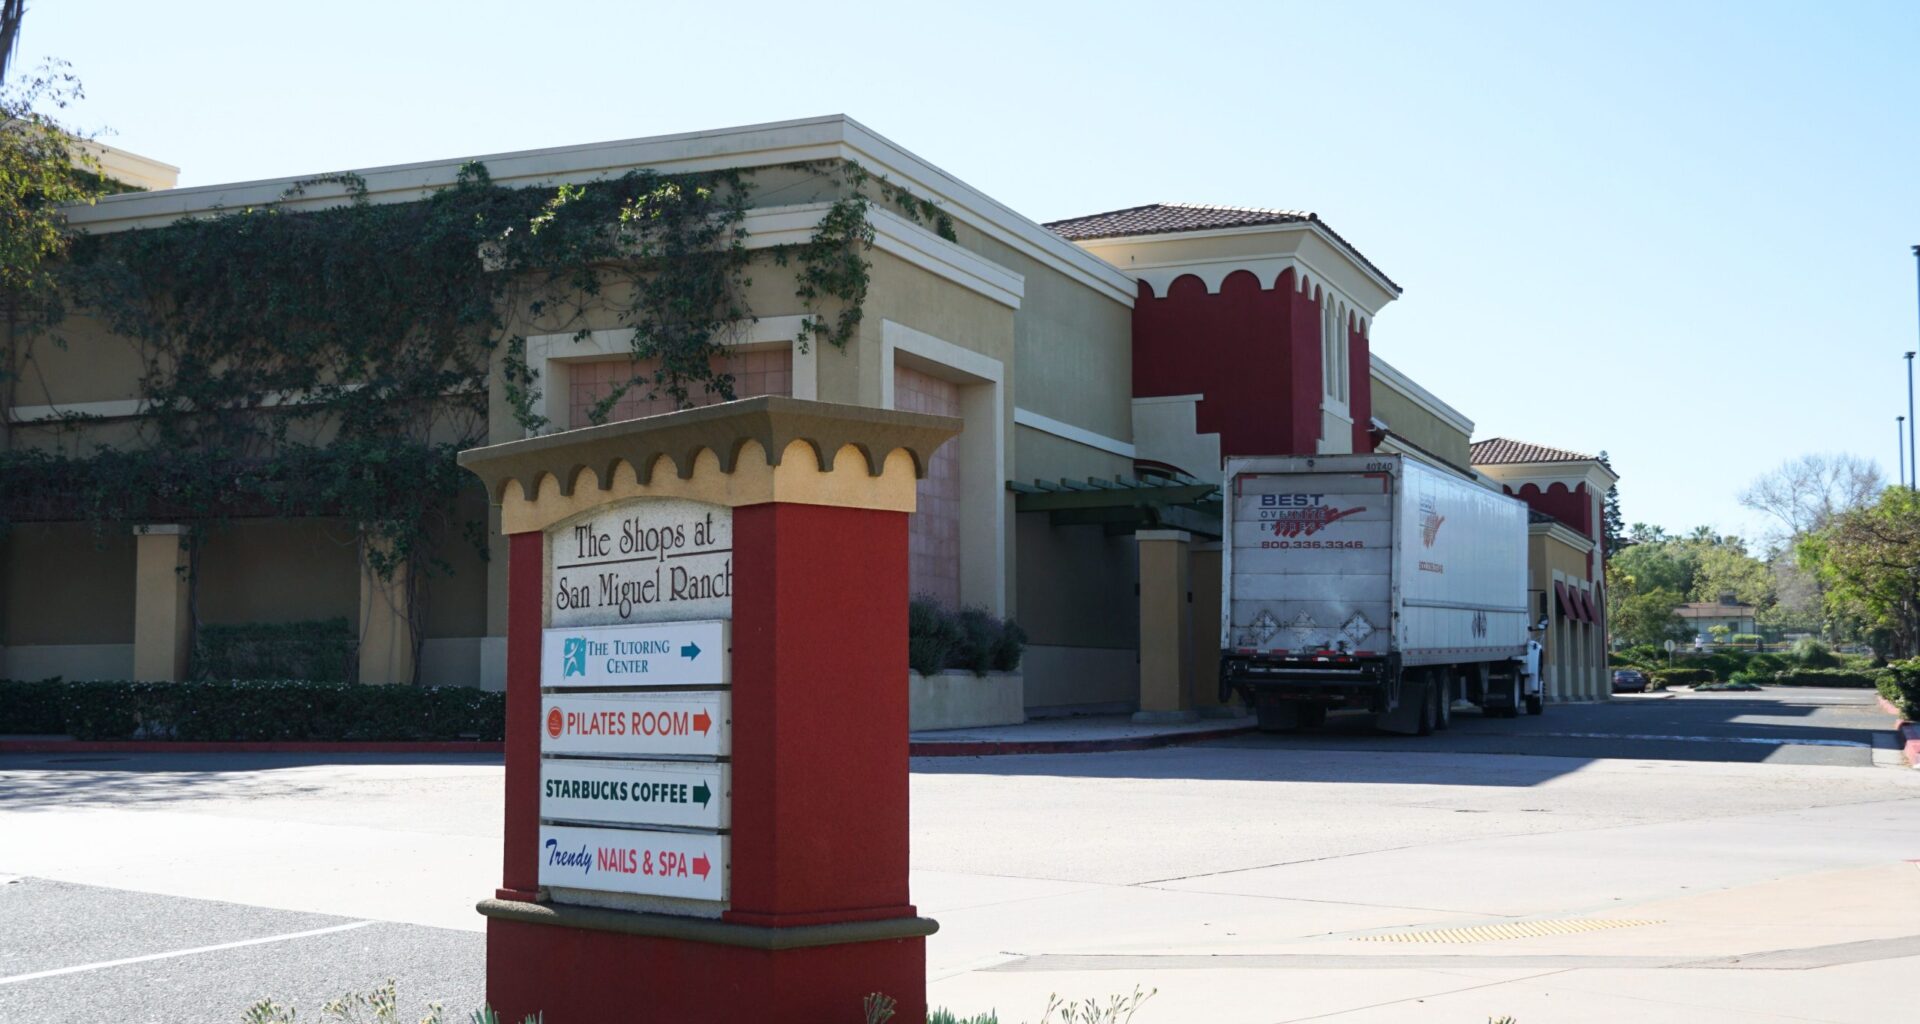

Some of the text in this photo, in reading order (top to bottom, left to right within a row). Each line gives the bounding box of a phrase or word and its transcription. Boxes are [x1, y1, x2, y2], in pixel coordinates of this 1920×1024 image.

[1261, 494, 1324, 506] BEST
[575, 512, 715, 562] The Shops at
[556, 577, 590, 610] San
[598, 567, 660, 619] Miguel
[588, 640, 670, 656] THE TUTORING
[606, 658, 649, 674] CENTER
[567, 711, 689, 736] PILATES ROOM
[545, 779, 688, 804] STARBUCKS COFFEE
[545, 838, 688, 879] Trendy NAILS & SPA
